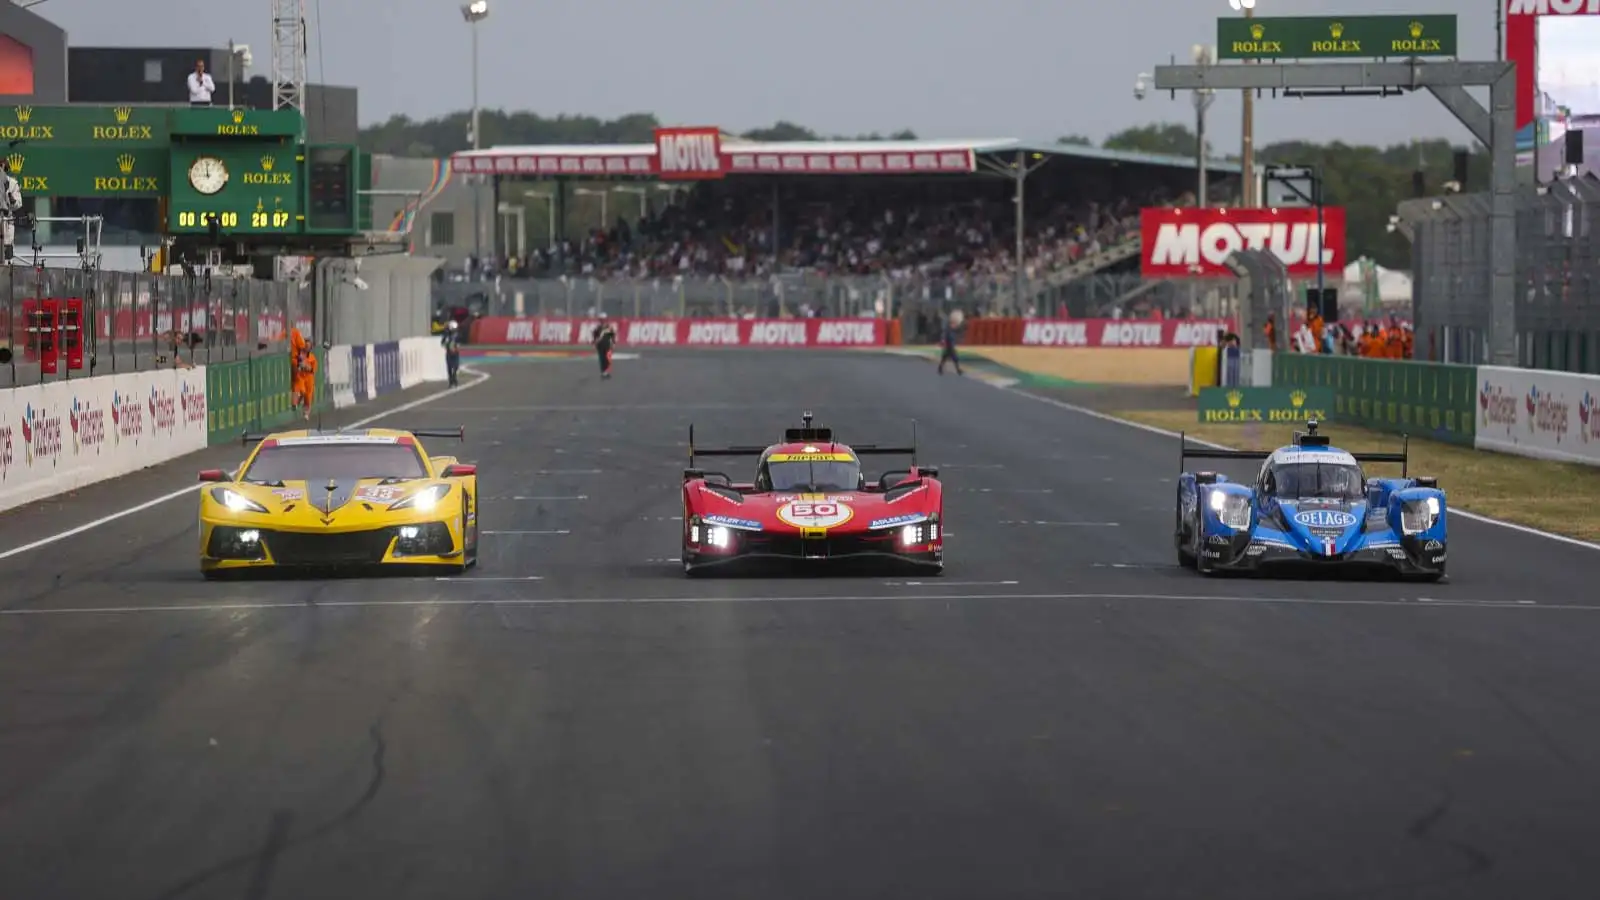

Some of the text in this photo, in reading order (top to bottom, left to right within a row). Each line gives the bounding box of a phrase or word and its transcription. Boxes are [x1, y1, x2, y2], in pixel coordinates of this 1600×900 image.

[1232, 39, 1441, 53] ROLEX ROLEX ROLEX
[93, 126, 152, 138] ROLEX
[217, 124, 259, 135] ROLEX
[659, 134, 720, 171] MOTUL
[94, 177, 158, 190] ROLEX
[243, 173, 292, 184] ROLEX
[179, 212, 195, 227] 00
[221, 212, 237, 227] 00
[273, 212, 288, 227] 07
[1150, 222, 1335, 266] MOTUL
[626, 322, 677, 344] MOTUL
[687, 322, 740, 344] MOTUL
[749, 322, 808, 344] MOTUL
[816, 322, 876, 344] MOTUL
[1022, 322, 1088, 345] MOTUL
[1101, 322, 1163, 345] MOTUL
[1205, 409, 1326, 421] ROLEX ROLEX
[794, 504, 834, 516] 50
[1301, 511, 1350, 525] DELAGE
